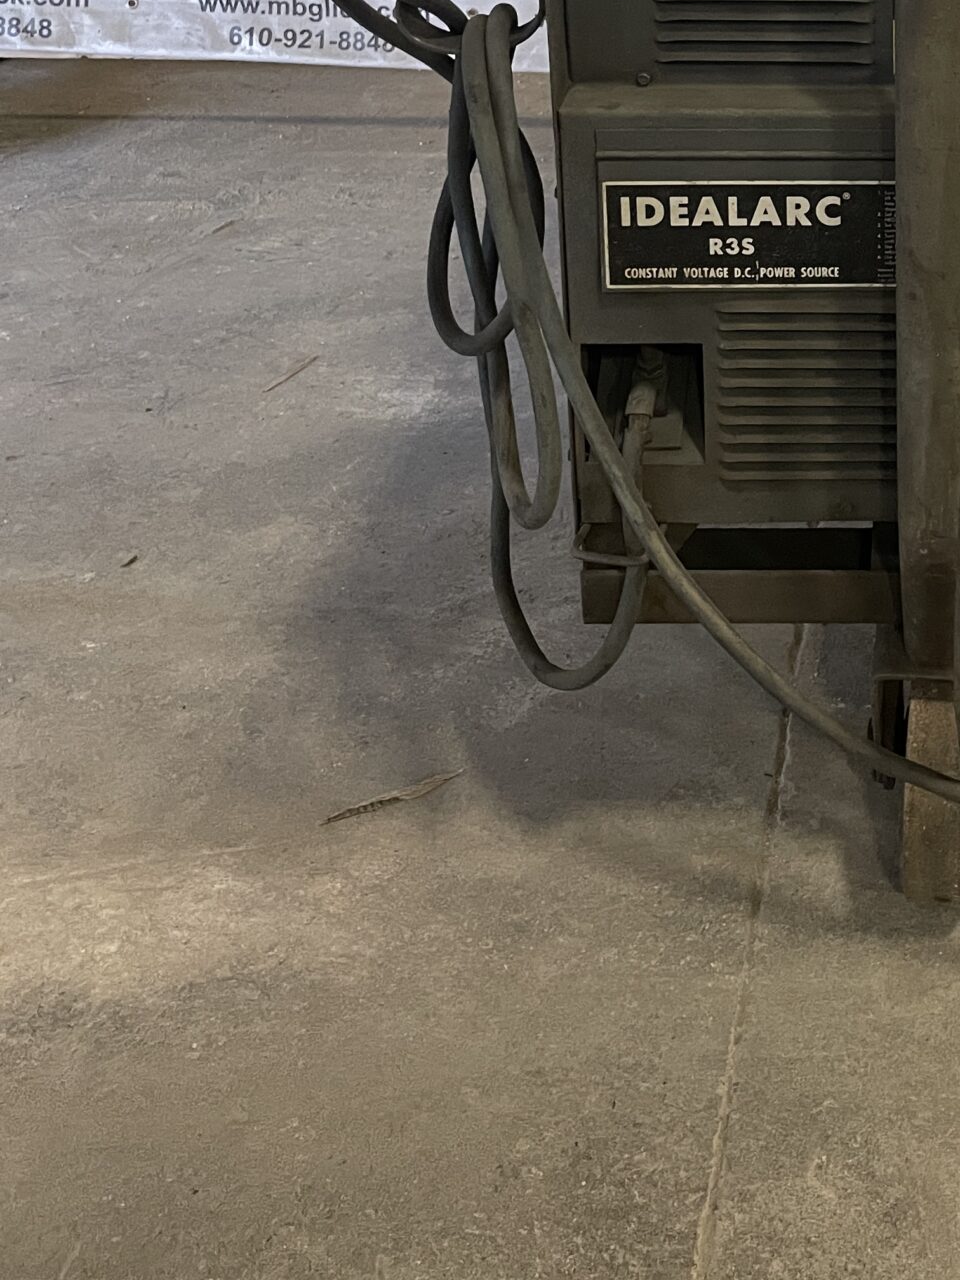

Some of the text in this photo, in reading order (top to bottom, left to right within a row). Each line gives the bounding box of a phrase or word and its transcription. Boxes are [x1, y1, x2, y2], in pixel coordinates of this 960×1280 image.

[620, 196, 842, 226] IDEALARC
[709, 238, 755, 255] R3S
[625, 268, 677, 278] CONSTANT
[684, 268, 728, 278] VOLTAGE
[760, 269, 795, 278] POWER
[801, 268, 839, 278] SOURCE
